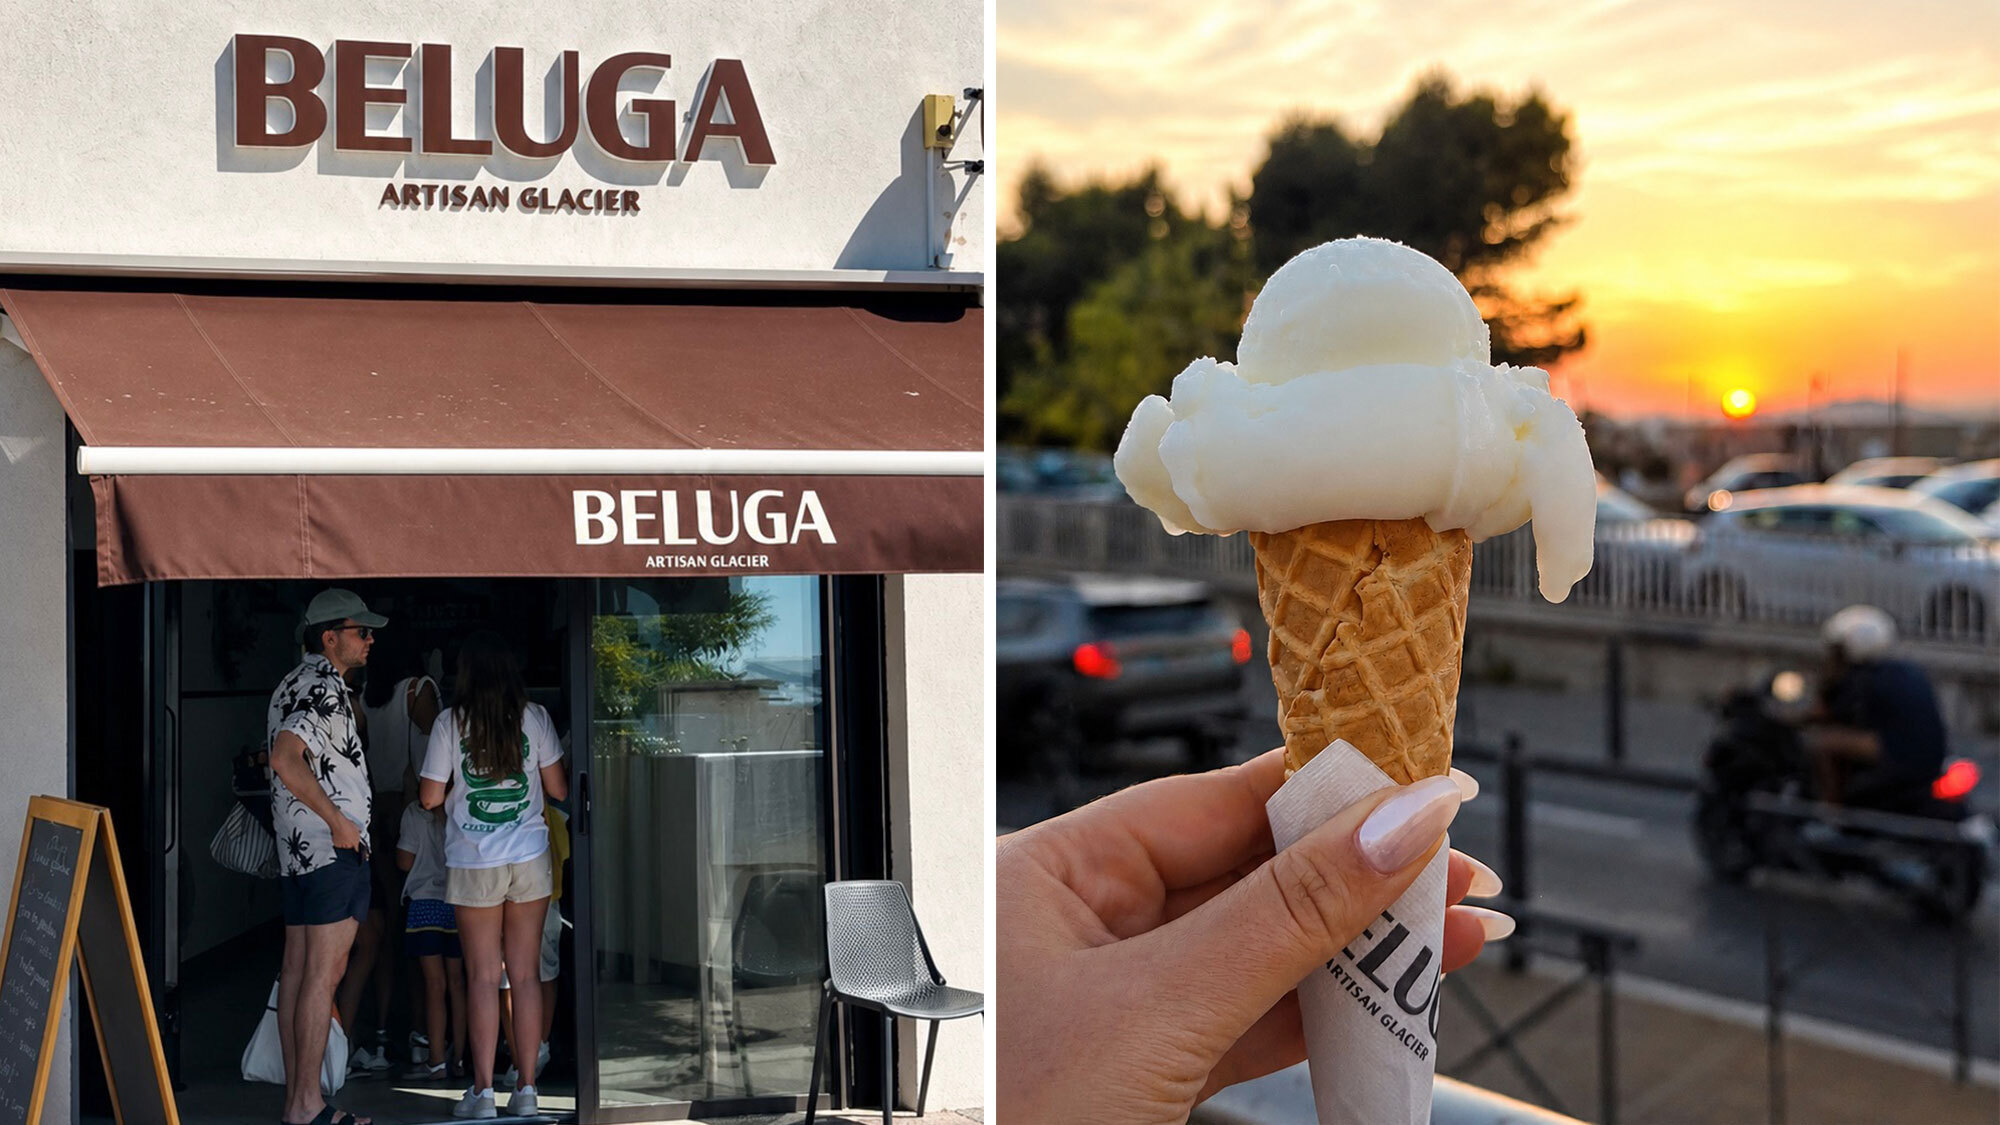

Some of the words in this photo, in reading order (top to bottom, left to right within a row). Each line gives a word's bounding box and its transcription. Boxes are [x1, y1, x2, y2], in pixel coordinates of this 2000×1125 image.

[233, 33, 777, 166] BELUGA
[380, 183, 510, 208] ARTISAN
[520, 187, 641, 212] GLACIER
[572, 489, 838, 546] BELUGA
[645, 555, 707, 569] ARTISAN
[710, 554, 770, 568] GLACIER
[1380, 1013, 1429, 1062] GLACIER
